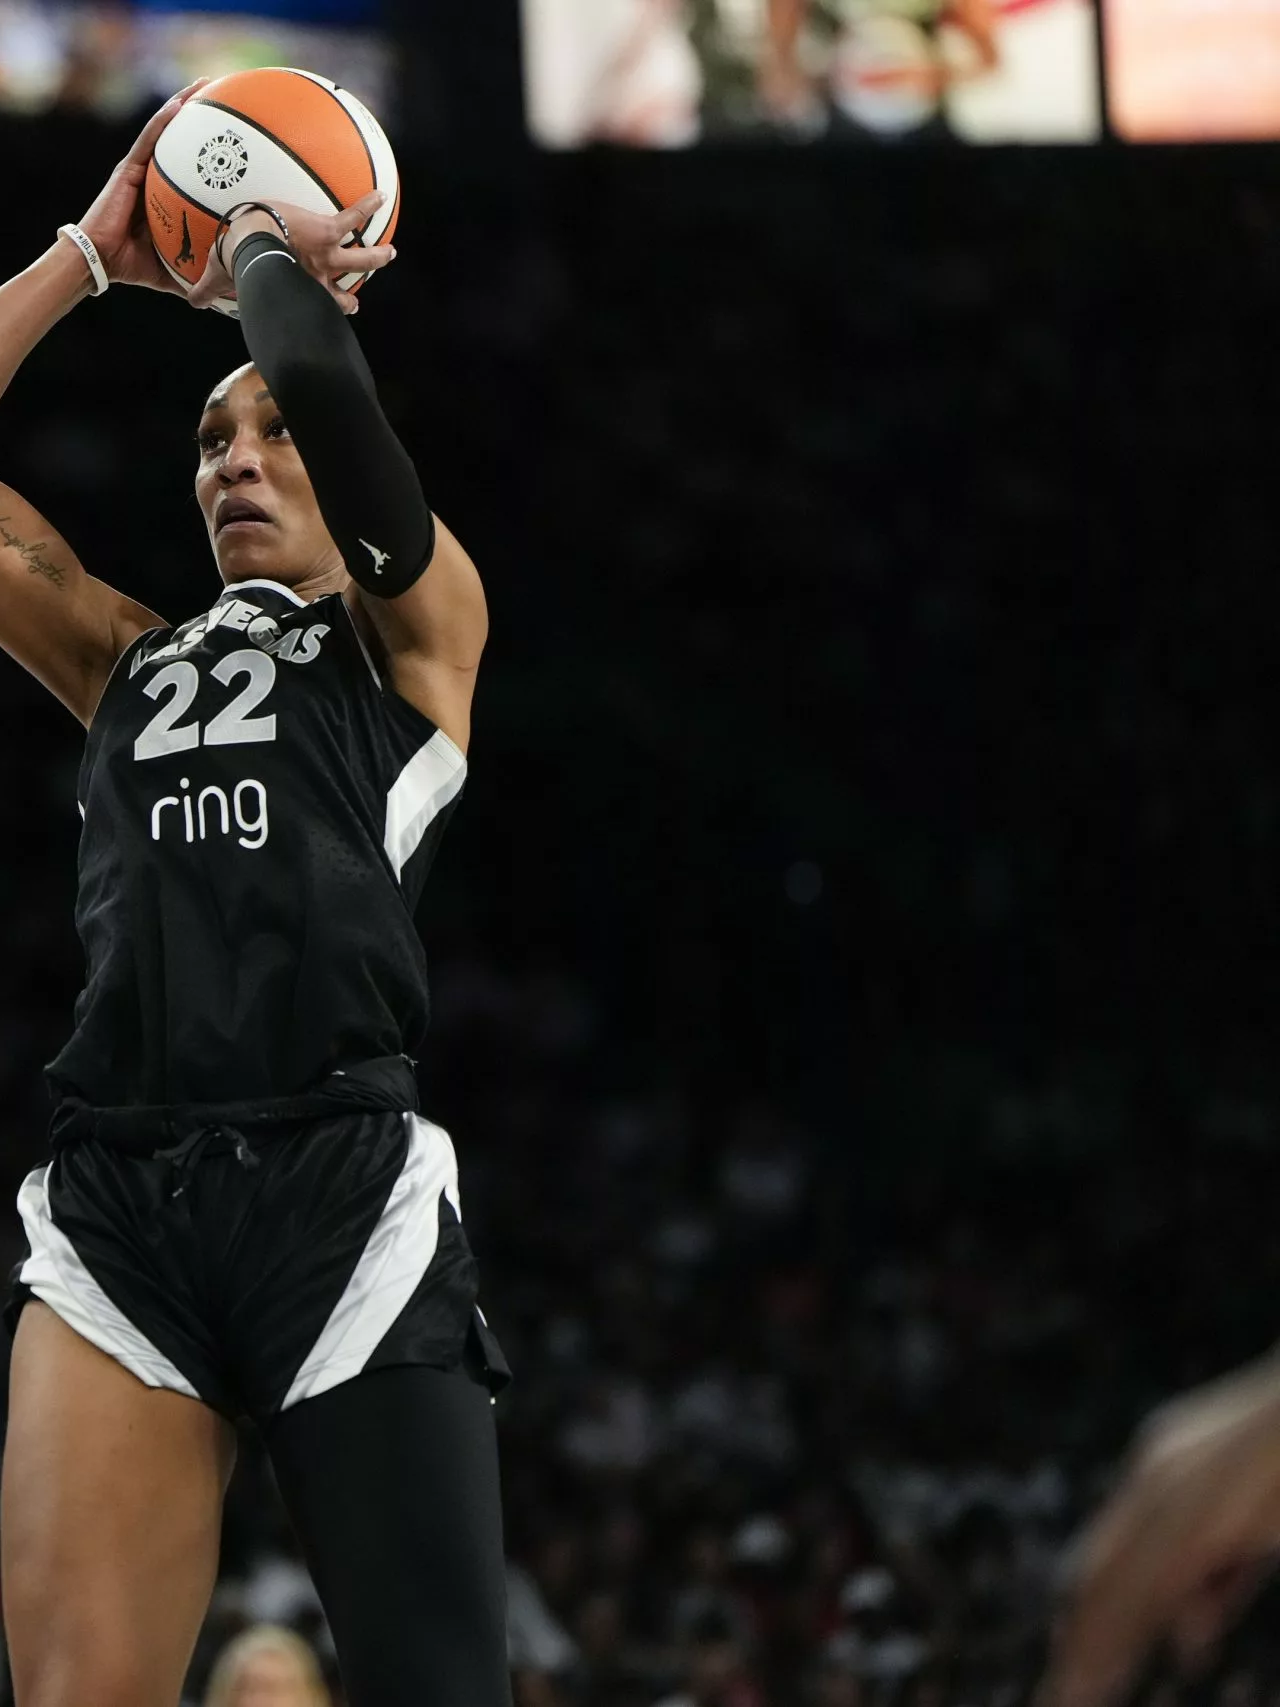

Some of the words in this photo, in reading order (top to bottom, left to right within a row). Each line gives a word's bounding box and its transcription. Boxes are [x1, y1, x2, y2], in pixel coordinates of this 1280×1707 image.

[205, 599, 331, 664] VEGAS
[133, 648, 277, 762] 22
[151, 777, 269, 850] ring
